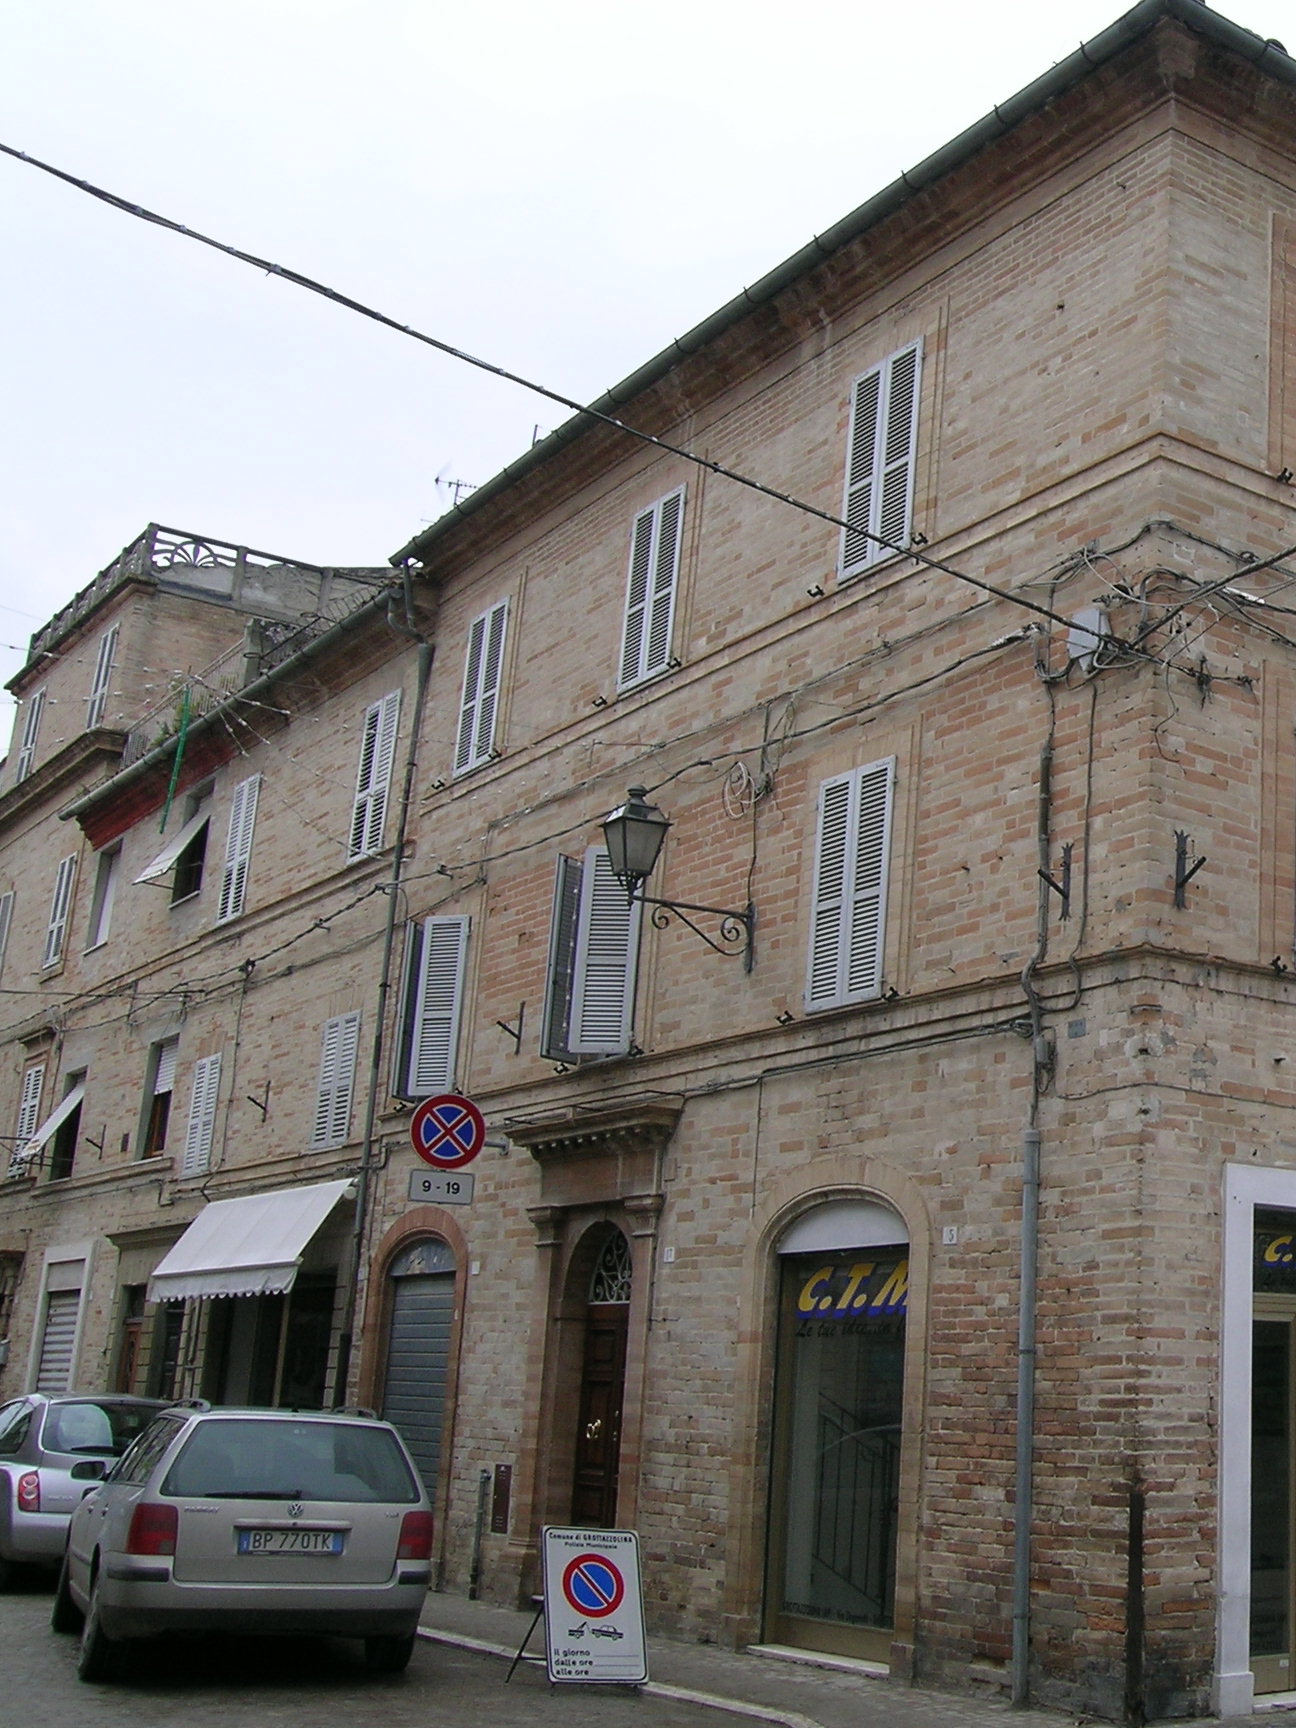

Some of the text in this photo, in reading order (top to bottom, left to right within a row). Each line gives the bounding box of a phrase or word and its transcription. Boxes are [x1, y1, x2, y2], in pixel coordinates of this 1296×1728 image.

[422, 1180, 431, 1192] 9
[445, 1181, 460, 1195] 19
[947, 1228, 955, 1243] 5
[252, 1532, 274, 1550] BP
[280, 1532, 332, 1551] 770TK
[548, 1532, 633, 1544] Comune di GROTTAZZOLINA
[562, 1648, 591, 1658] giorno
[554, 1658, 577, 1667] dalle
[556, 1668, 572, 1676] alle
